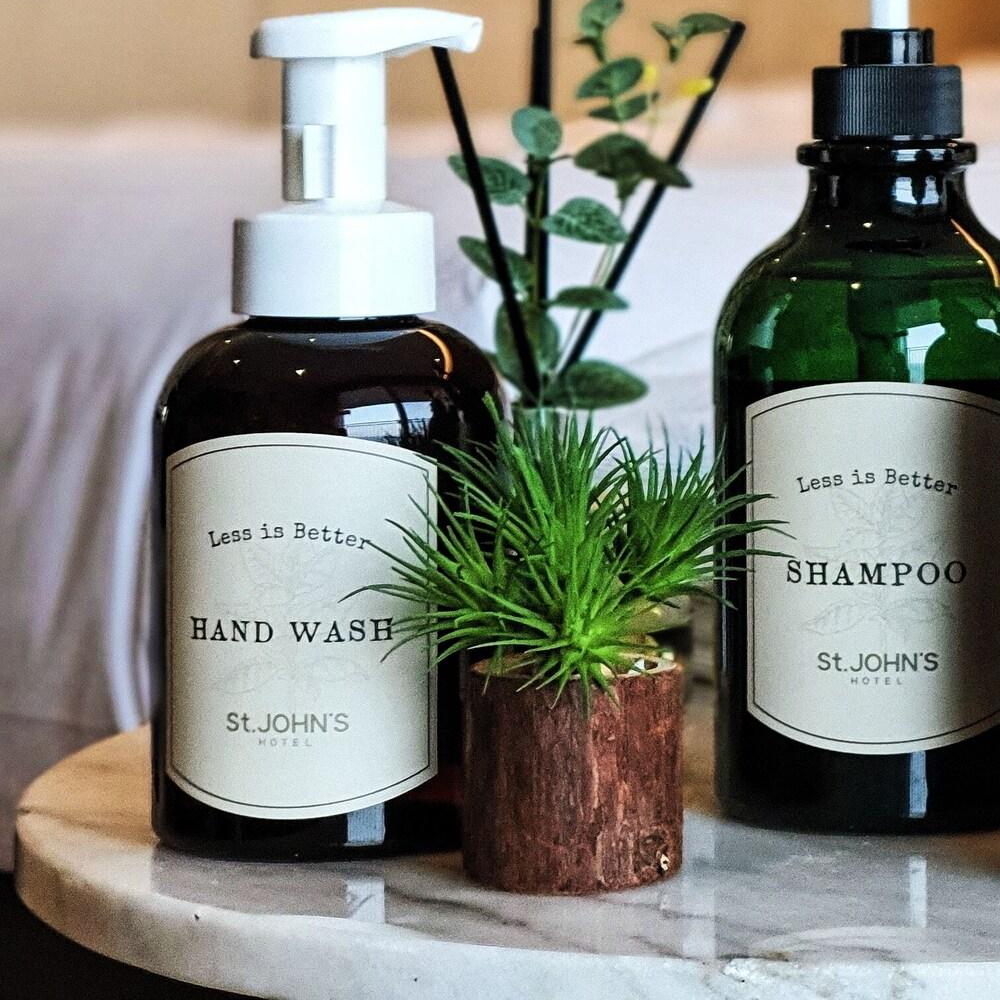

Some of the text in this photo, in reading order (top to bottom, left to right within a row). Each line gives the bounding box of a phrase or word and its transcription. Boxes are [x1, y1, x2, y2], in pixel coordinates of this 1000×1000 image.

[797, 468, 960, 497] Less is Better
[208, 522, 370, 551] Less is Better
[786, 559, 968, 587] SHAMPOO
[189, 615, 394, 643] HAND WASH
[850, 676, 902, 686] HOTEL
[257, 737, 313, 748] HOTEL
